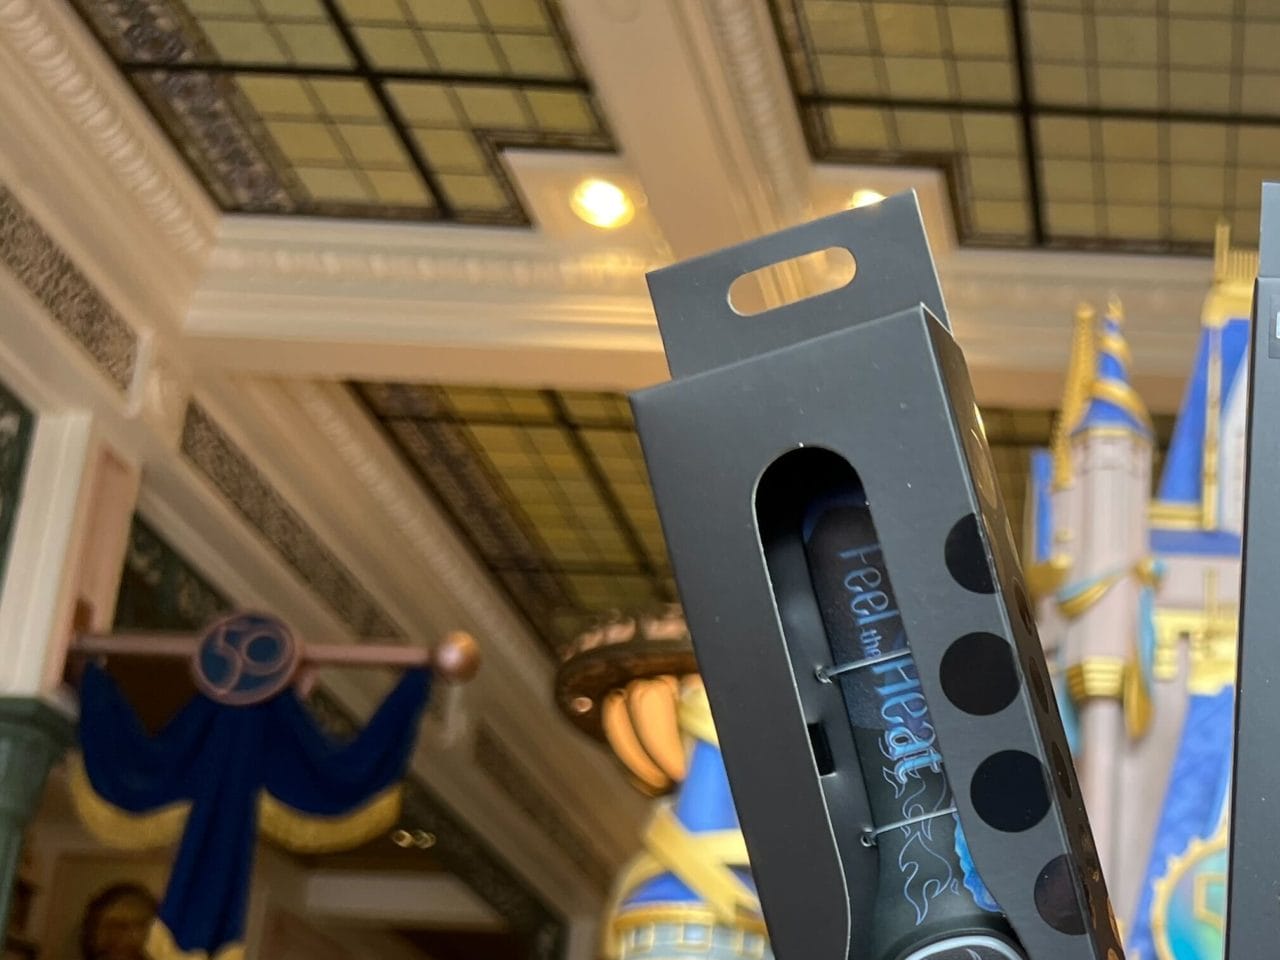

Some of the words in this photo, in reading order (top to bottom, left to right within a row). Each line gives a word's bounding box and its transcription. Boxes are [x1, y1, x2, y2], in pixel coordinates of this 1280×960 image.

[839, 543, 902, 626] Feel
[860, 627, 882, 659] the
[872, 655, 944, 784] Heat
